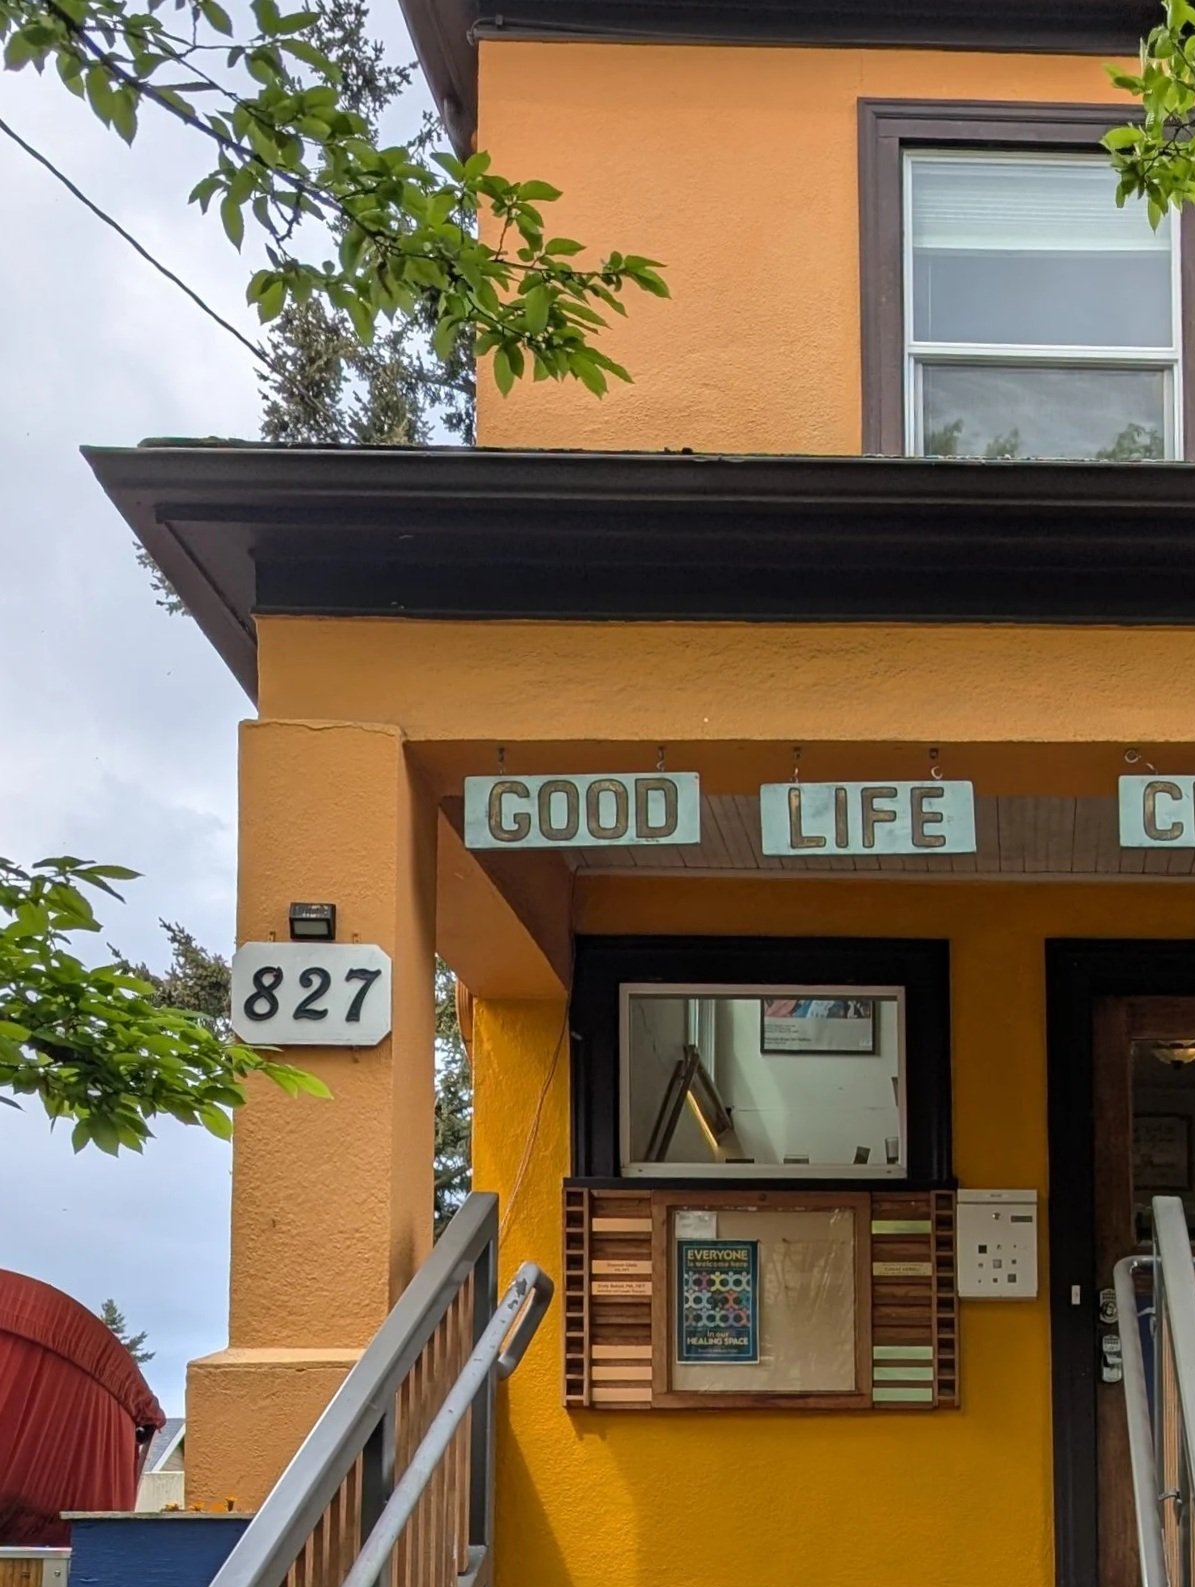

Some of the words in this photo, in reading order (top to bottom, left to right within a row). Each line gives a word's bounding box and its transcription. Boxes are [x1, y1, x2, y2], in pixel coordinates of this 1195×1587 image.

[488, 778, 679, 842] GOOD
[787, 786, 947, 849] LIFE
[243, 965, 382, 1023] 827
[687, 1249, 748, 1260] EVERYONE
[687, 1337, 723, 1345] HEALING
[724, 1337, 748, 1345] SPACE
